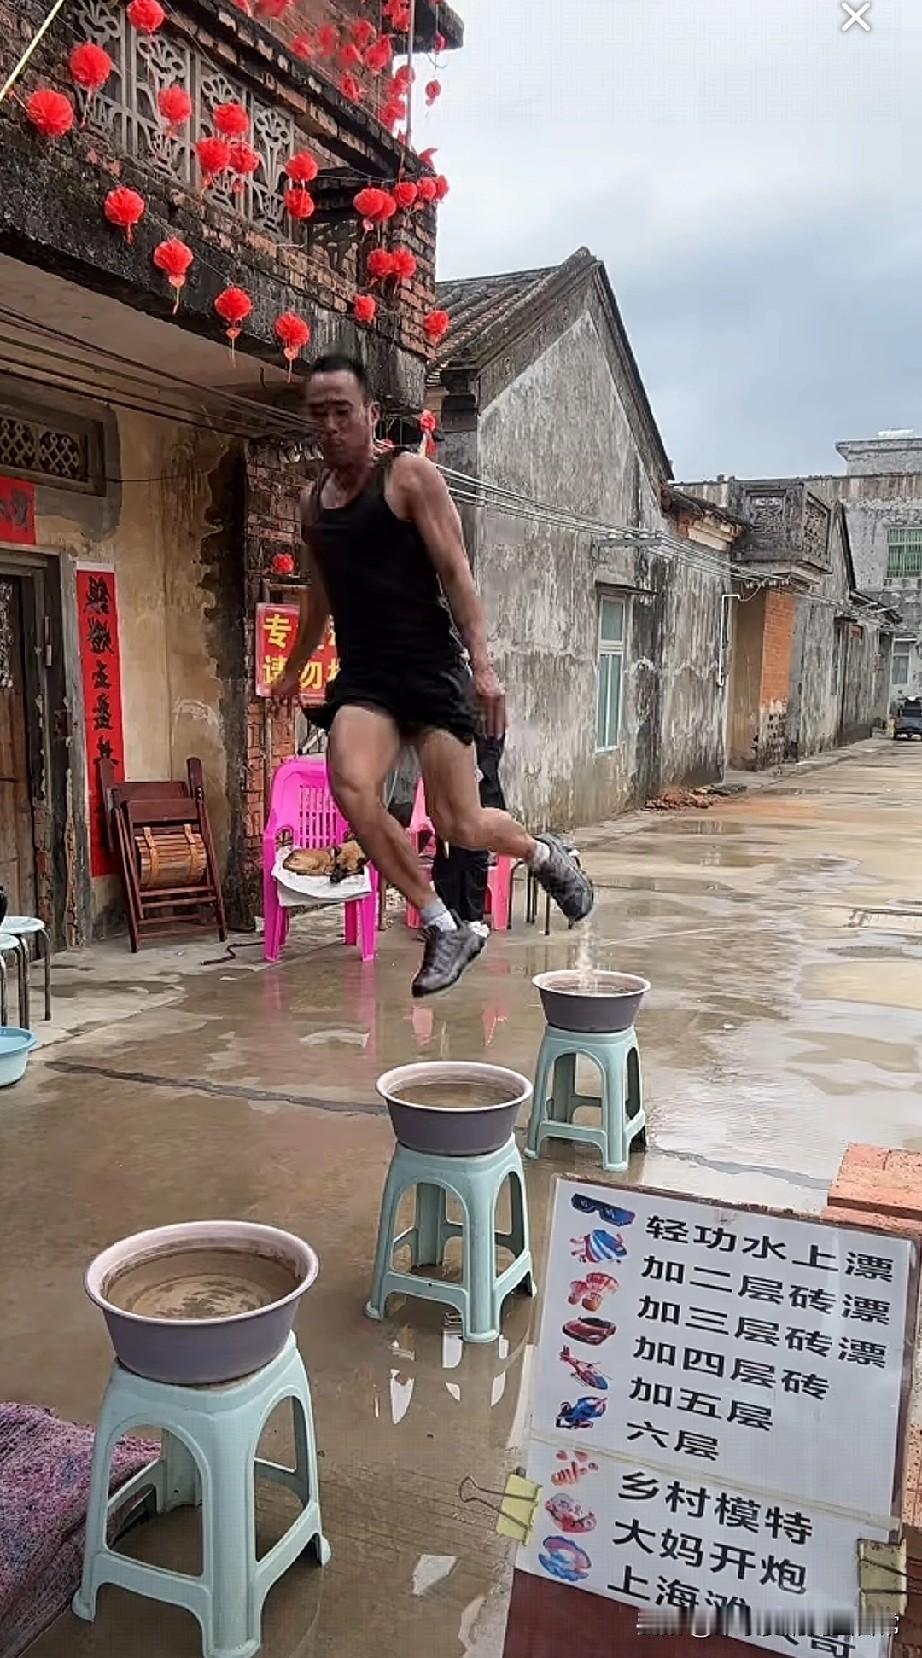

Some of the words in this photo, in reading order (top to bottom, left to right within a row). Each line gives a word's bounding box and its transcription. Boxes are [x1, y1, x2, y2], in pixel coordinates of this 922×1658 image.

[645, 1215, 895, 1283] 轻功水上漂
[641, 1255, 891, 1326] 加二层砖漂
[637, 1295, 888, 1369] 加三层砖漂
[633, 1335, 831, 1400] 加四层砖
[628, 1377, 774, 1432] 加五层
[626, 1421, 720, 1461] 六层
[617, 1471, 813, 1545] 乡村模特
[612, 1518, 807, 1595] 大妈开炮
